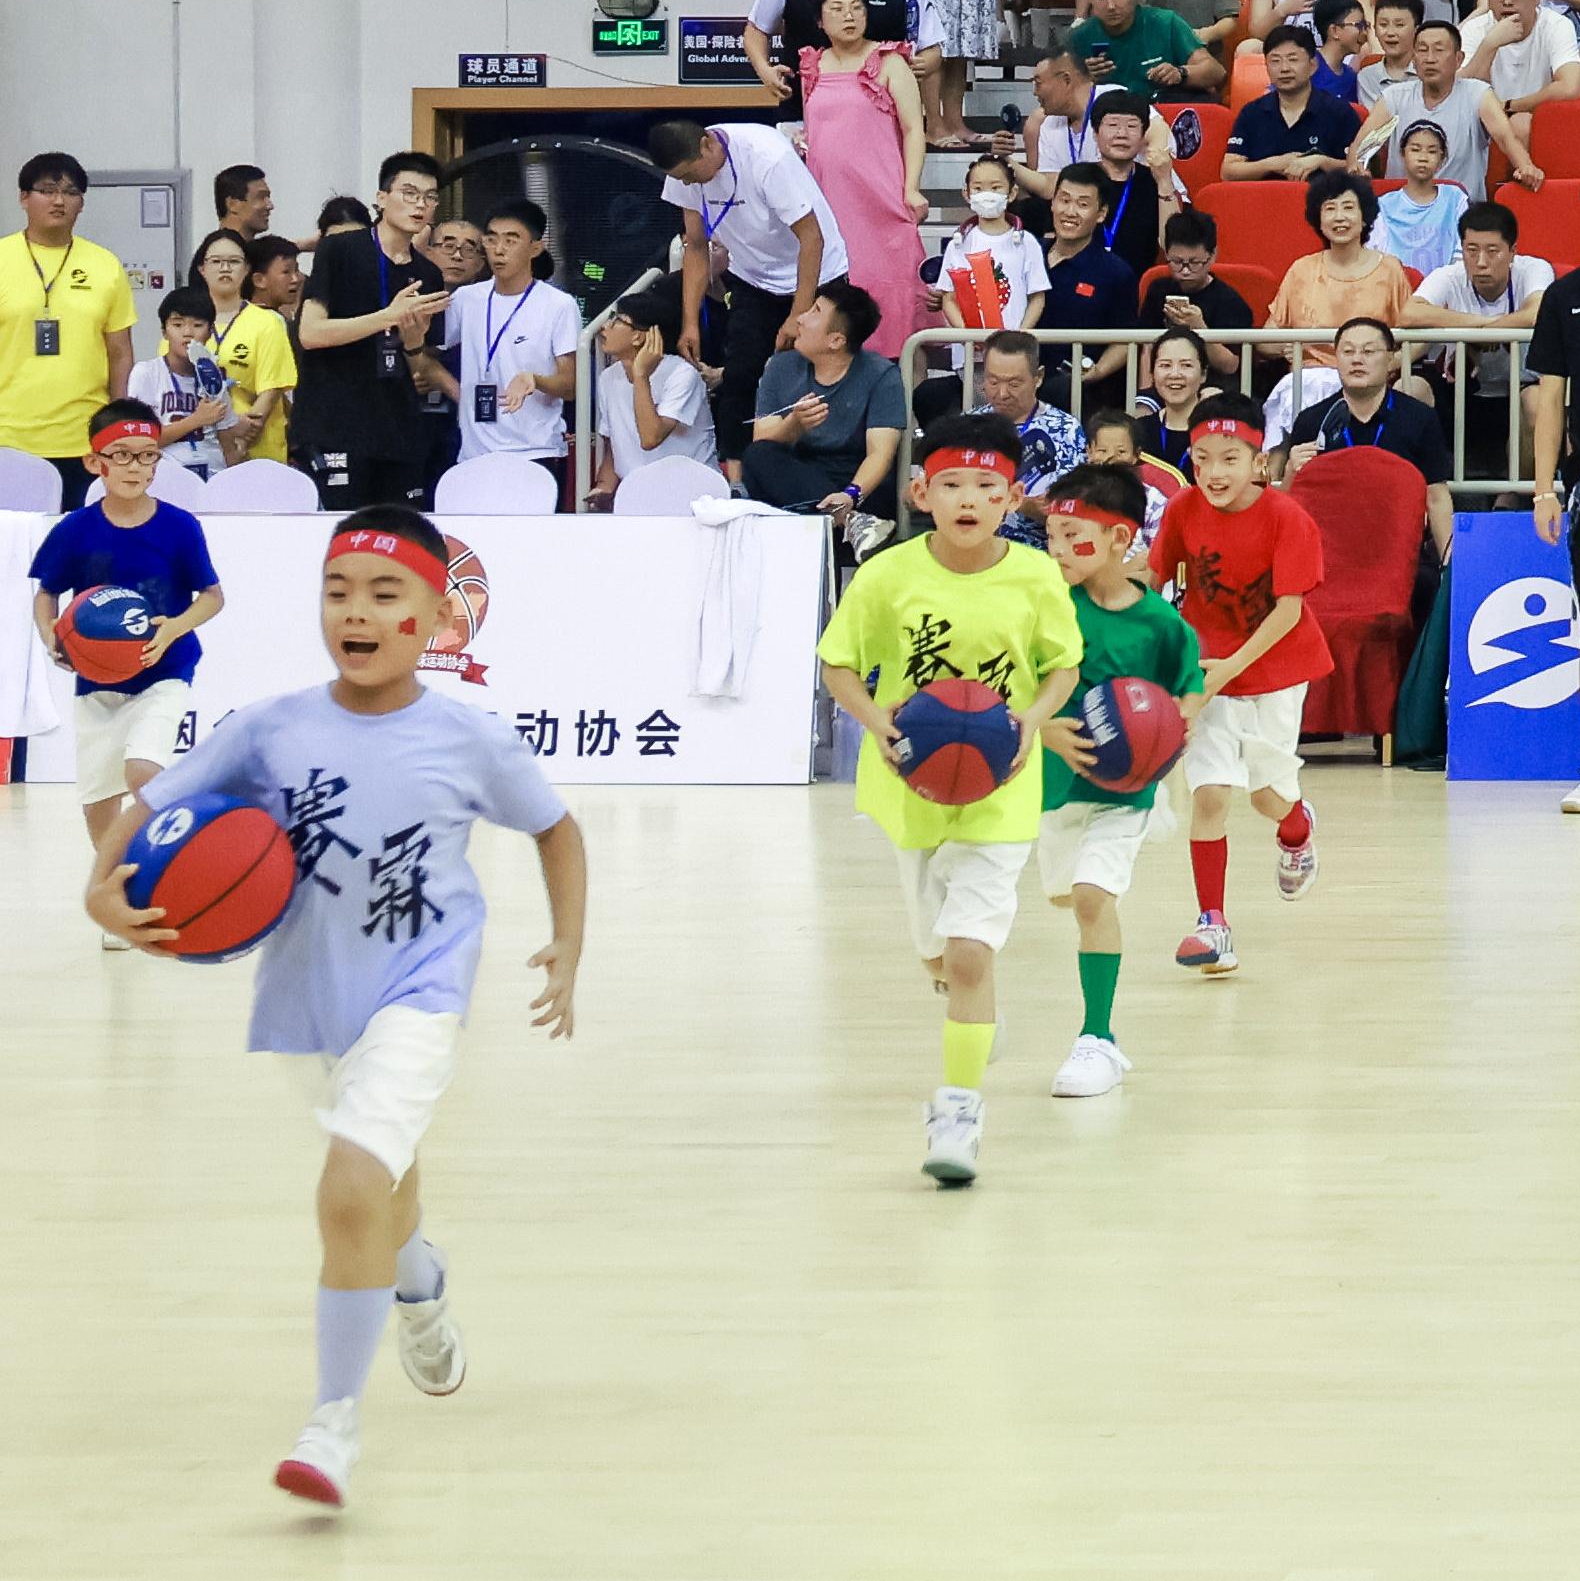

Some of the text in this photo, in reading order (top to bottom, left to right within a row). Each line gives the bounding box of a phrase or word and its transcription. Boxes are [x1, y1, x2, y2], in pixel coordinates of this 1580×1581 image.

[642, 31, 660, 40] EXIT
[467, 57, 537, 74] 球员通道
[687, 54, 719, 64] Global
[467, 74, 538, 85] Player Channel
[962, 448, 995, 468] 中国
[350, 530, 398, 555] 中国
